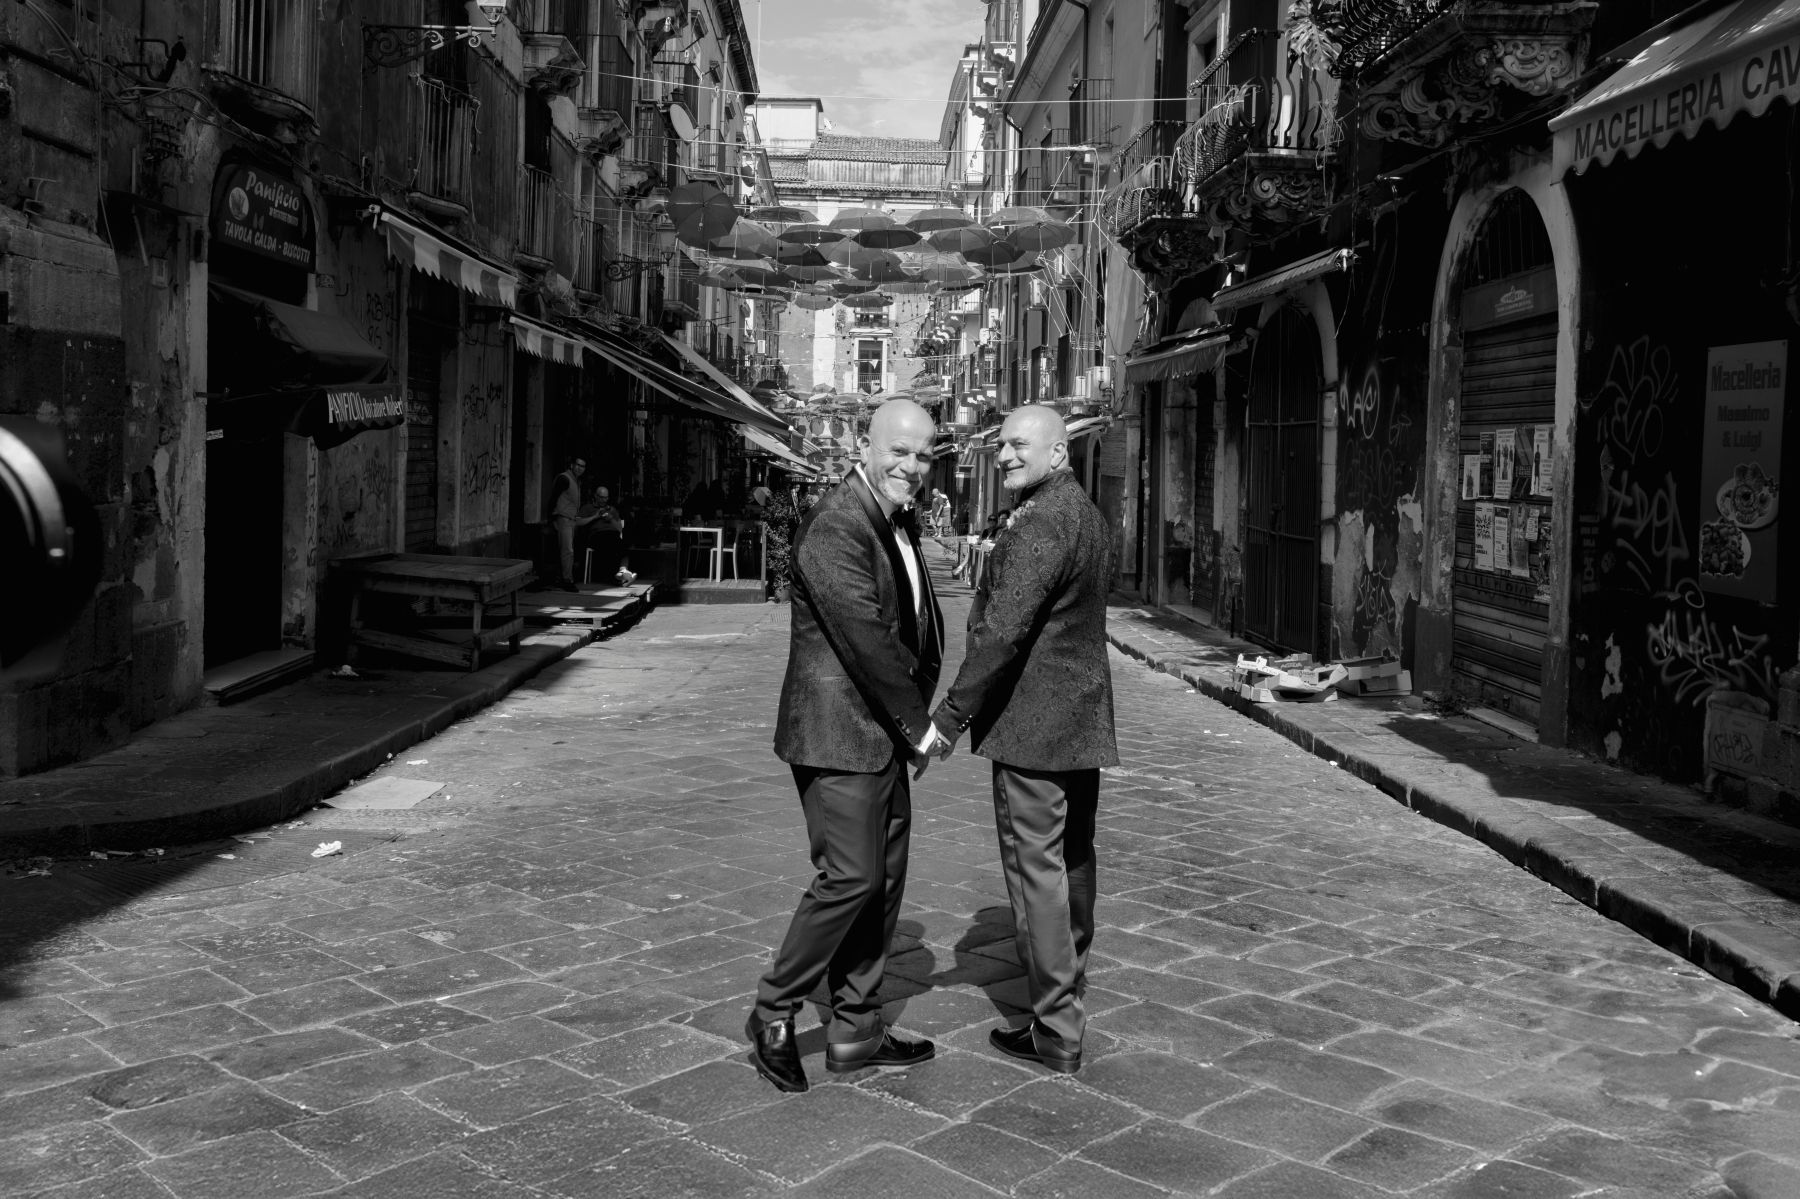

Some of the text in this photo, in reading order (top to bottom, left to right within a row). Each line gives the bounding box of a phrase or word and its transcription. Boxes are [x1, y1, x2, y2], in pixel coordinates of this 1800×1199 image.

[1575, 72, 1724, 161] MACELLERIA
[245, 170, 300, 212] Panificio
[224, 219, 253, 245] TAVOLA
[254, 231, 277, 253] CALDA
[282, 241, 311, 263] BISCOTTI
[1711, 361, 1781, 392] Macelleria
[327, 391, 364, 424] PANIFICIO
[1717, 404, 1770, 422] Massimo
[1722, 430, 1762, 452] & Luigi
